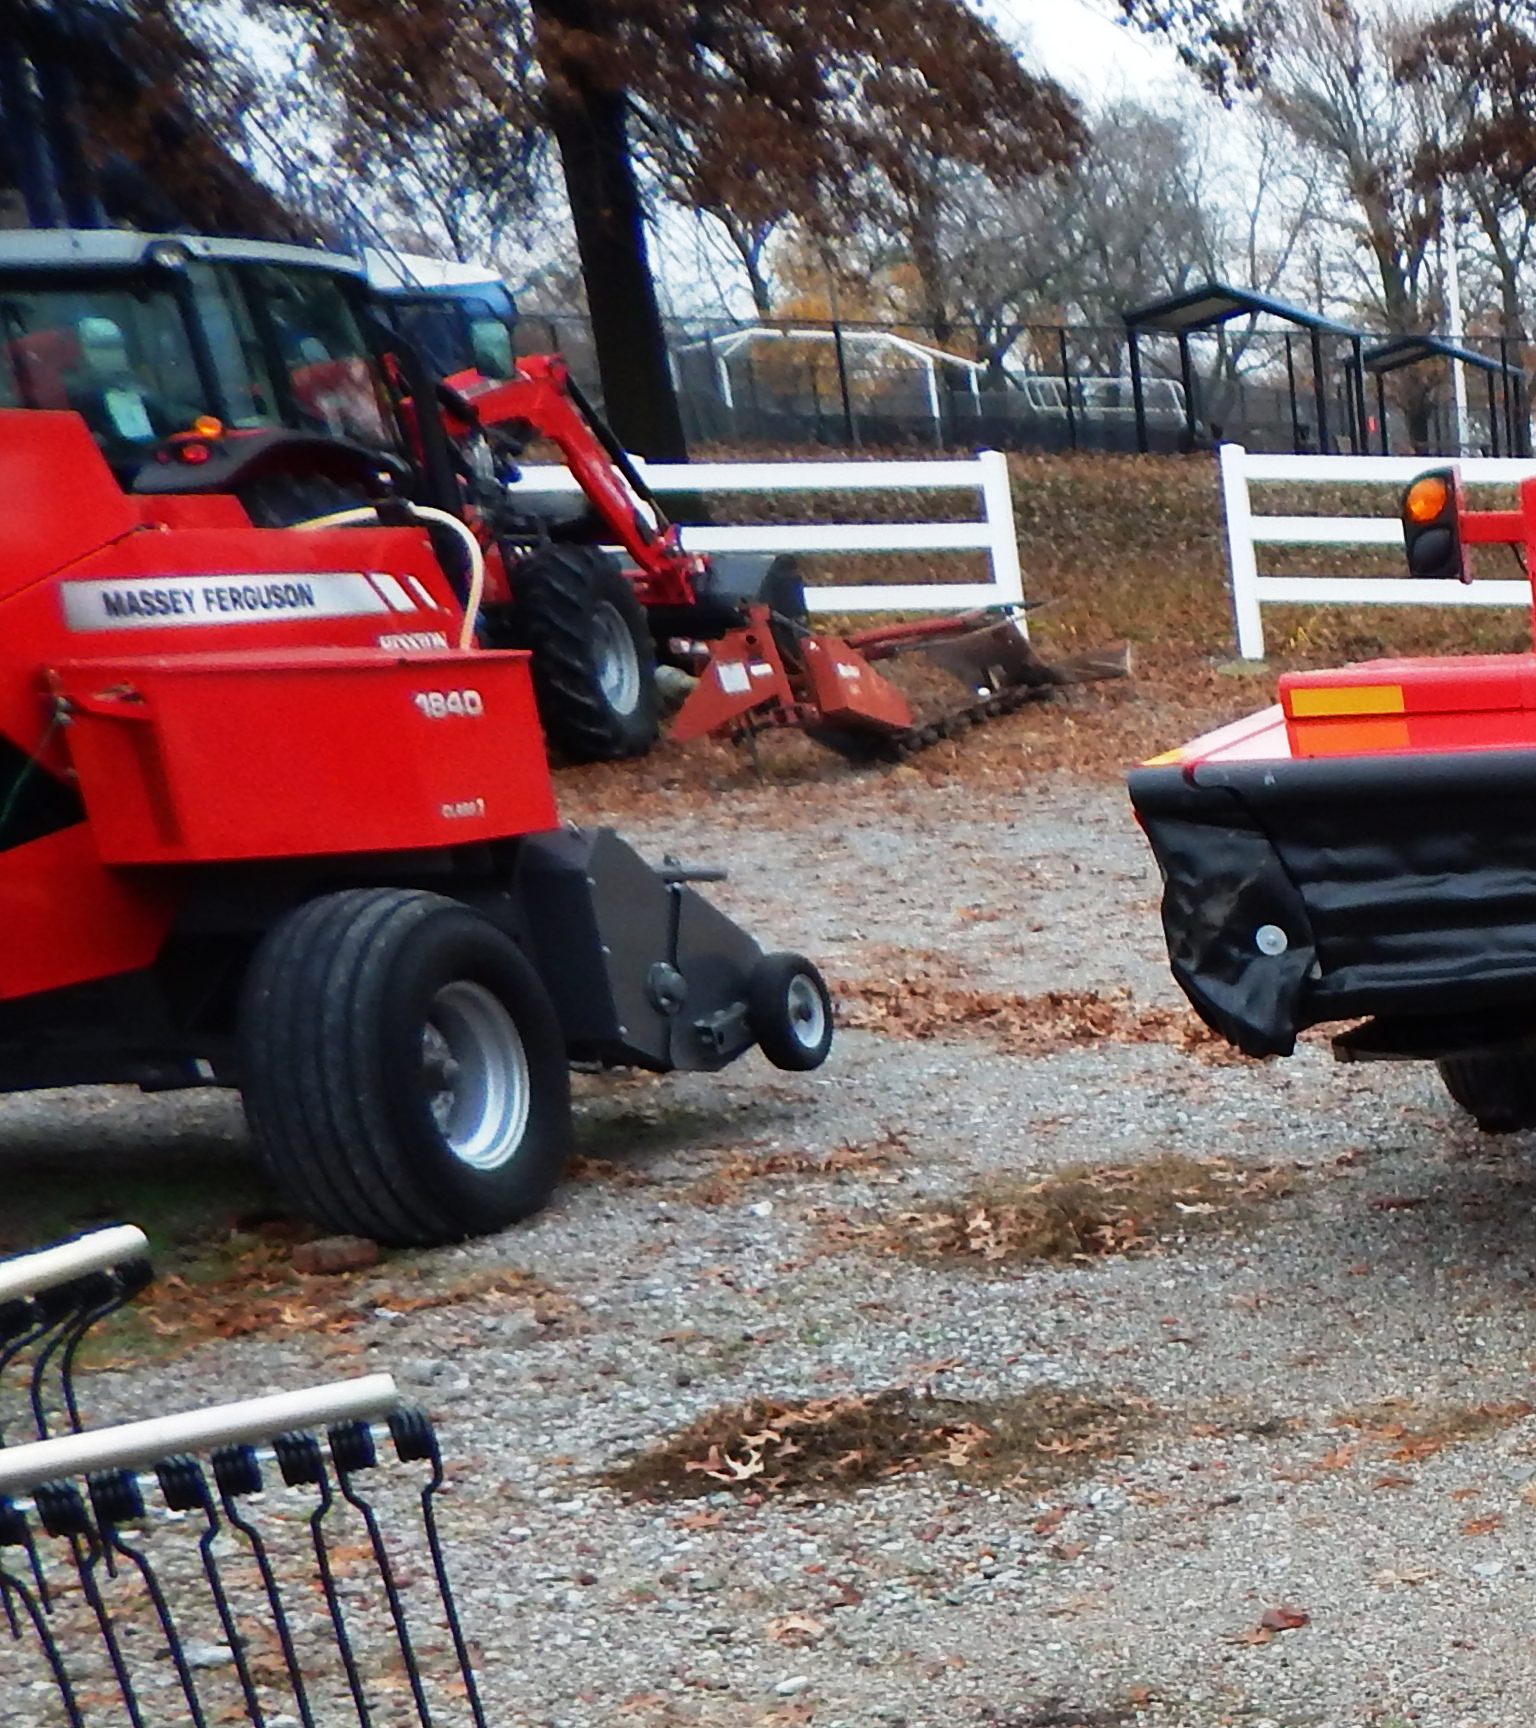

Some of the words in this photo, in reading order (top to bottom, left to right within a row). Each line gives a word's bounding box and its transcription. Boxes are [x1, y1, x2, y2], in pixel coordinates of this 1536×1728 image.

[101, 584, 197, 618] MASSEY
[204, 582, 316, 613] FERGUSON
[415, 689, 485, 719] 1840
